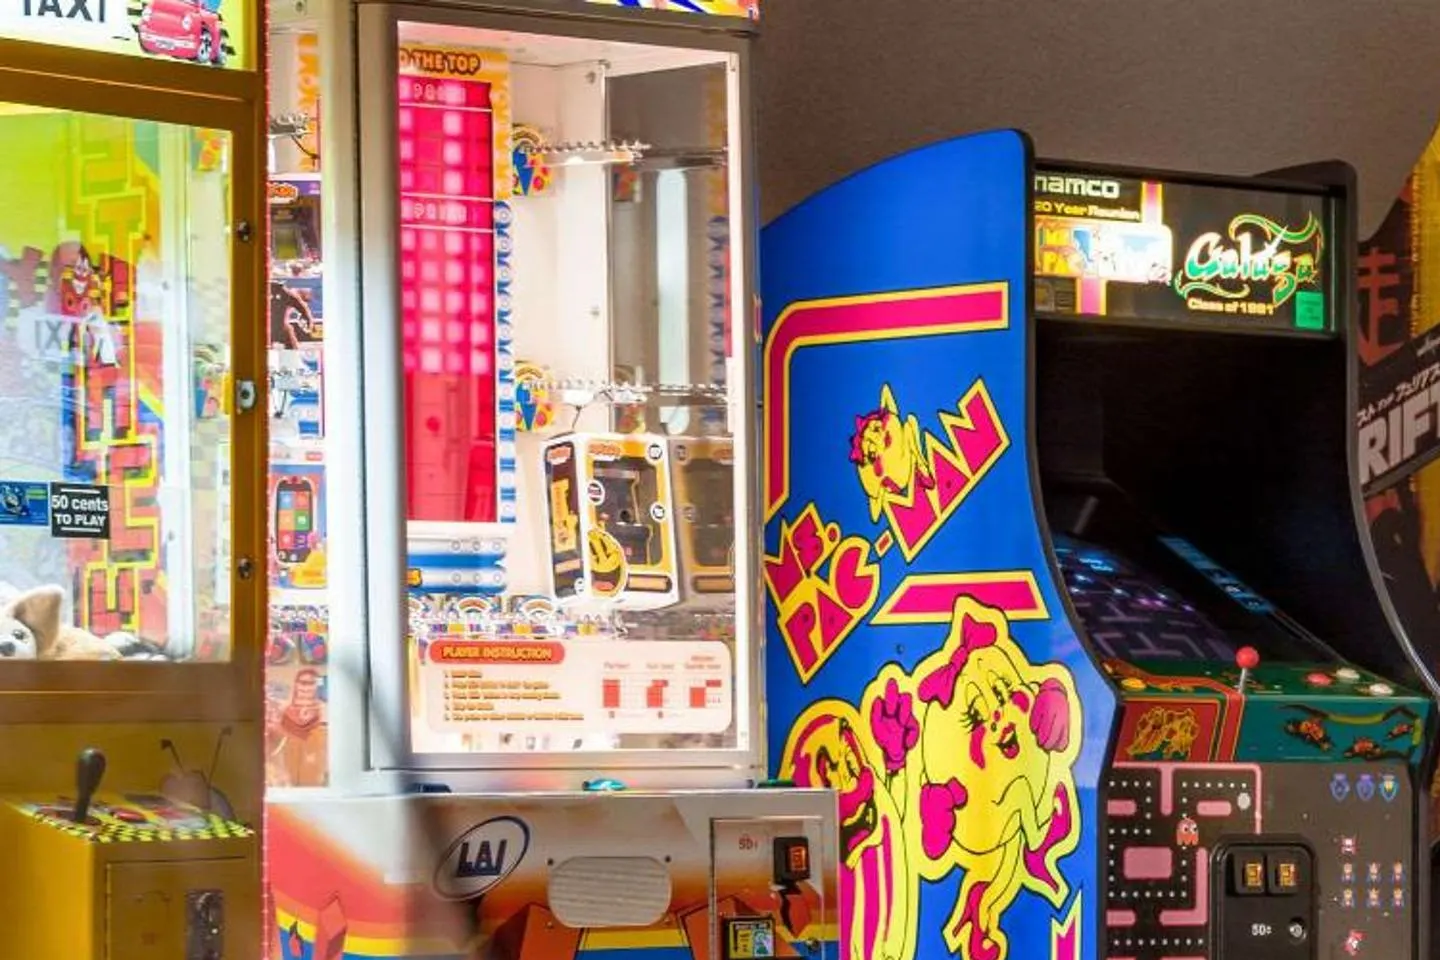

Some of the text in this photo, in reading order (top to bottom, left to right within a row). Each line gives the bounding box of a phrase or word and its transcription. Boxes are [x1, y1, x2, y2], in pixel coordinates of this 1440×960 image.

[413, 52, 444, 70] THE
[445, 55, 480, 75] TOP
[1034, 175, 1120, 199] namco
[1054, 203, 1088, 216] Year
[1088, 205, 1141, 220] Reunion
[1185, 230, 1318, 306] Galaga
[1187, 297, 1274, 316] Class of 1981
[51, 494, 109, 512] 50 cents
[54, 513, 106, 527] TO PLAY
[778, 377, 1012, 684] PAC-MAN
[441, 646, 552, 661] PLAYER INSTRUCTION
[455, 838, 508, 878] LAI
